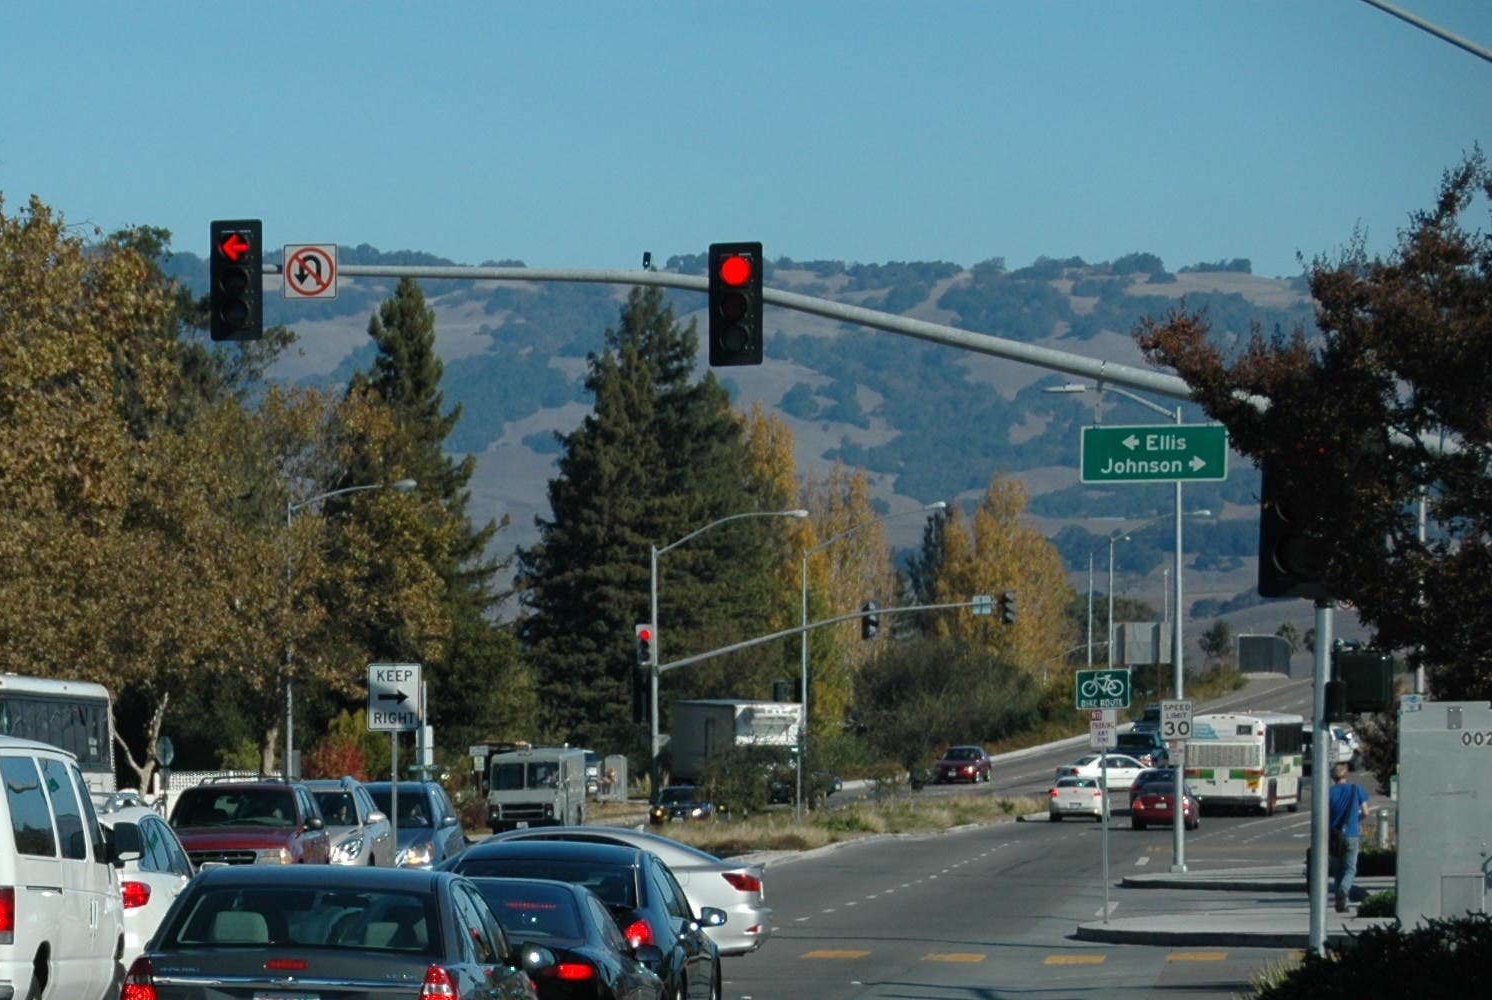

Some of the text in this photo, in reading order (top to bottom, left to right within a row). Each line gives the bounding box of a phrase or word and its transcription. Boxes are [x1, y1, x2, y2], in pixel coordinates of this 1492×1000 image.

[1145, 433, 1187, 451] Ellis
[1100, 456, 1183, 474] Johnson
[376, 669, 413, 682] KEEP
[1080, 697, 1123, 708] BIKE ROUTE
[1163, 703, 1190, 711] SPEED
[373, 711, 415, 725] RIGHT
[1165, 711, 1187, 719] LIMIT
[1164, 721, 1190, 736] 30
